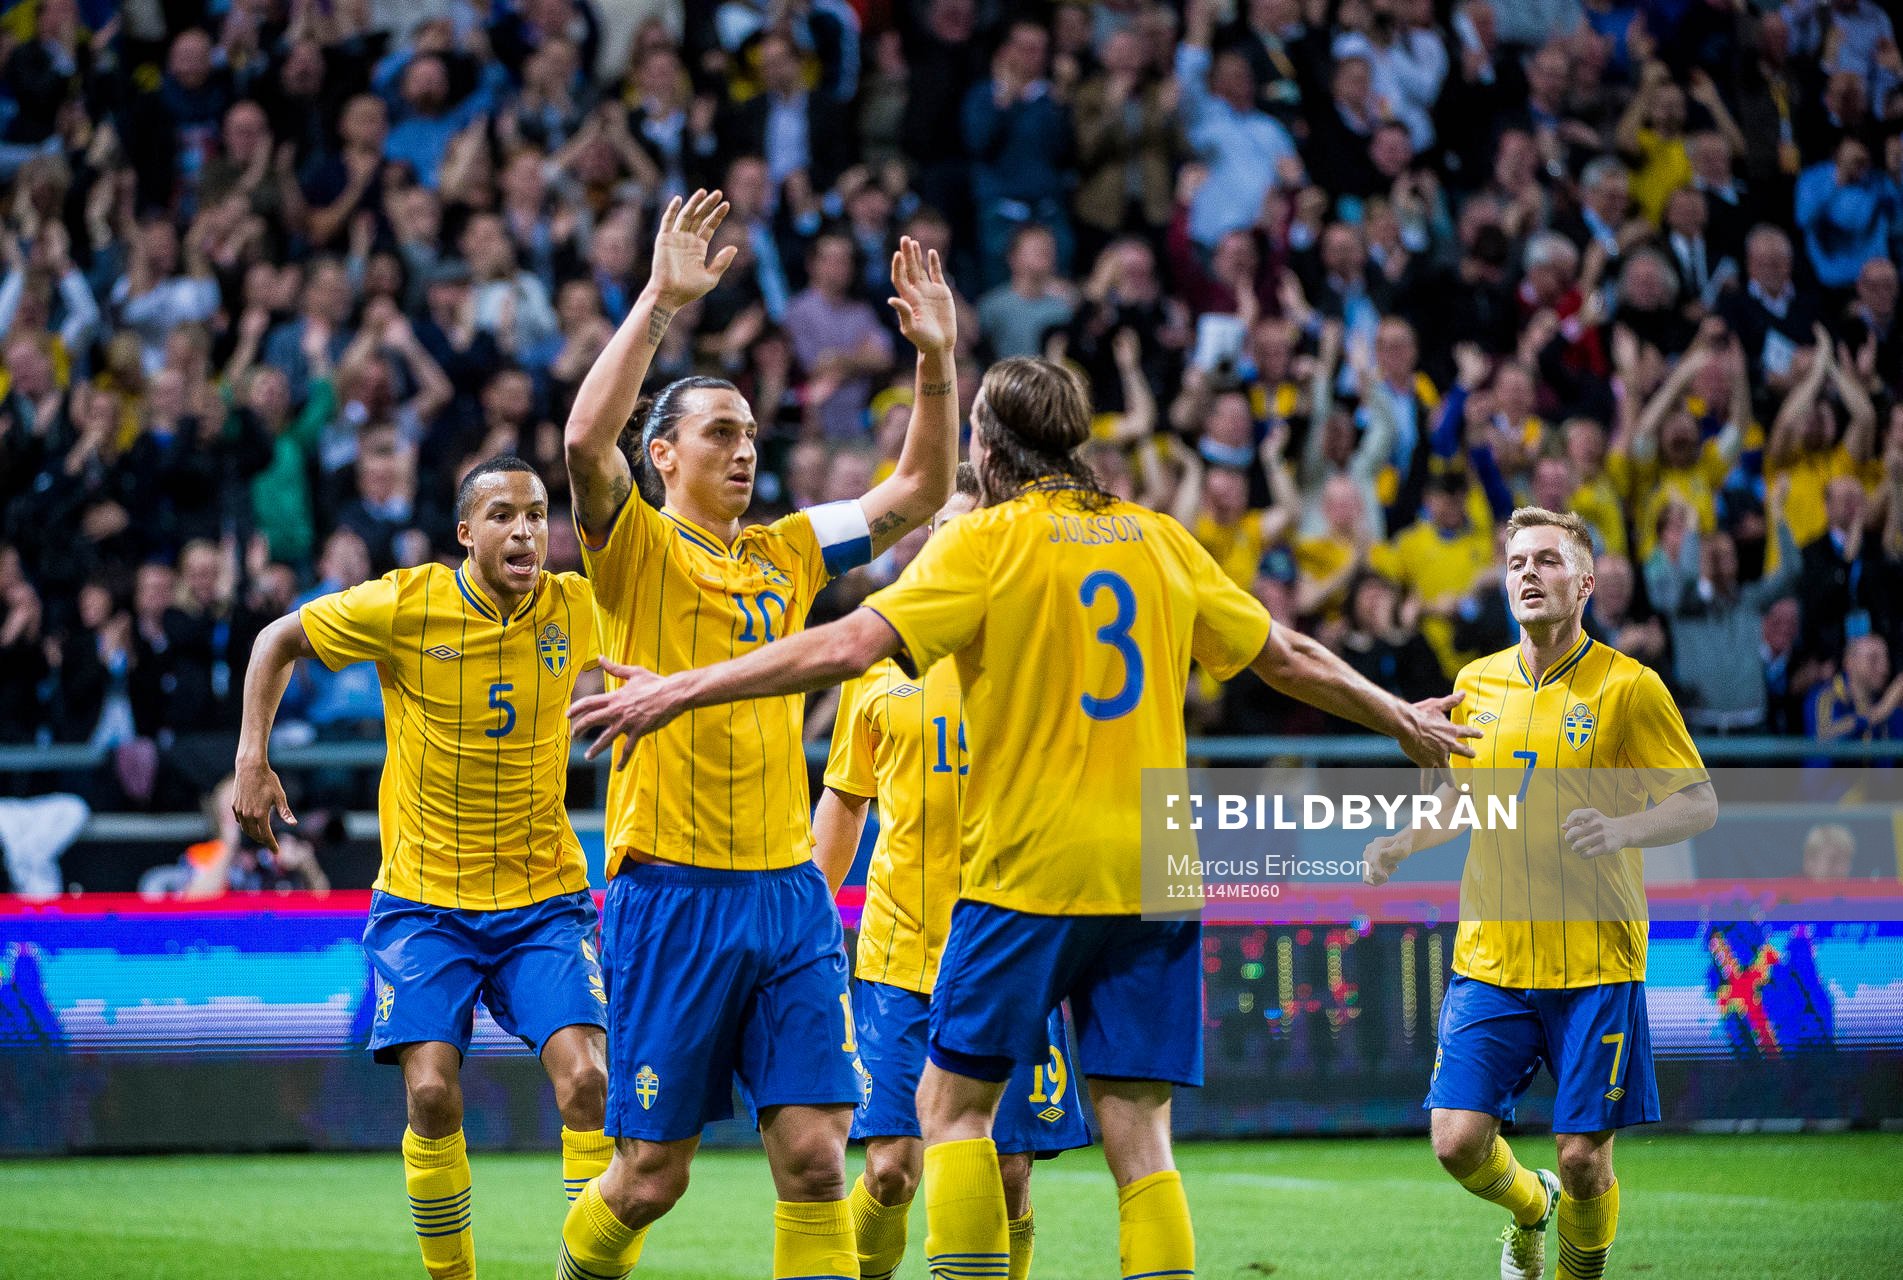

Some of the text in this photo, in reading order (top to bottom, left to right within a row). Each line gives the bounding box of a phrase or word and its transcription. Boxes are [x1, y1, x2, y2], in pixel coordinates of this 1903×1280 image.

[1079, 570, 1145, 720] 3
[485, 683, 517, 738] 5
[1512, 750, 1538, 803] 7
[1028, 1045, 1068, 1105] 19
[1601, 1032, 1625, 1086] 7
